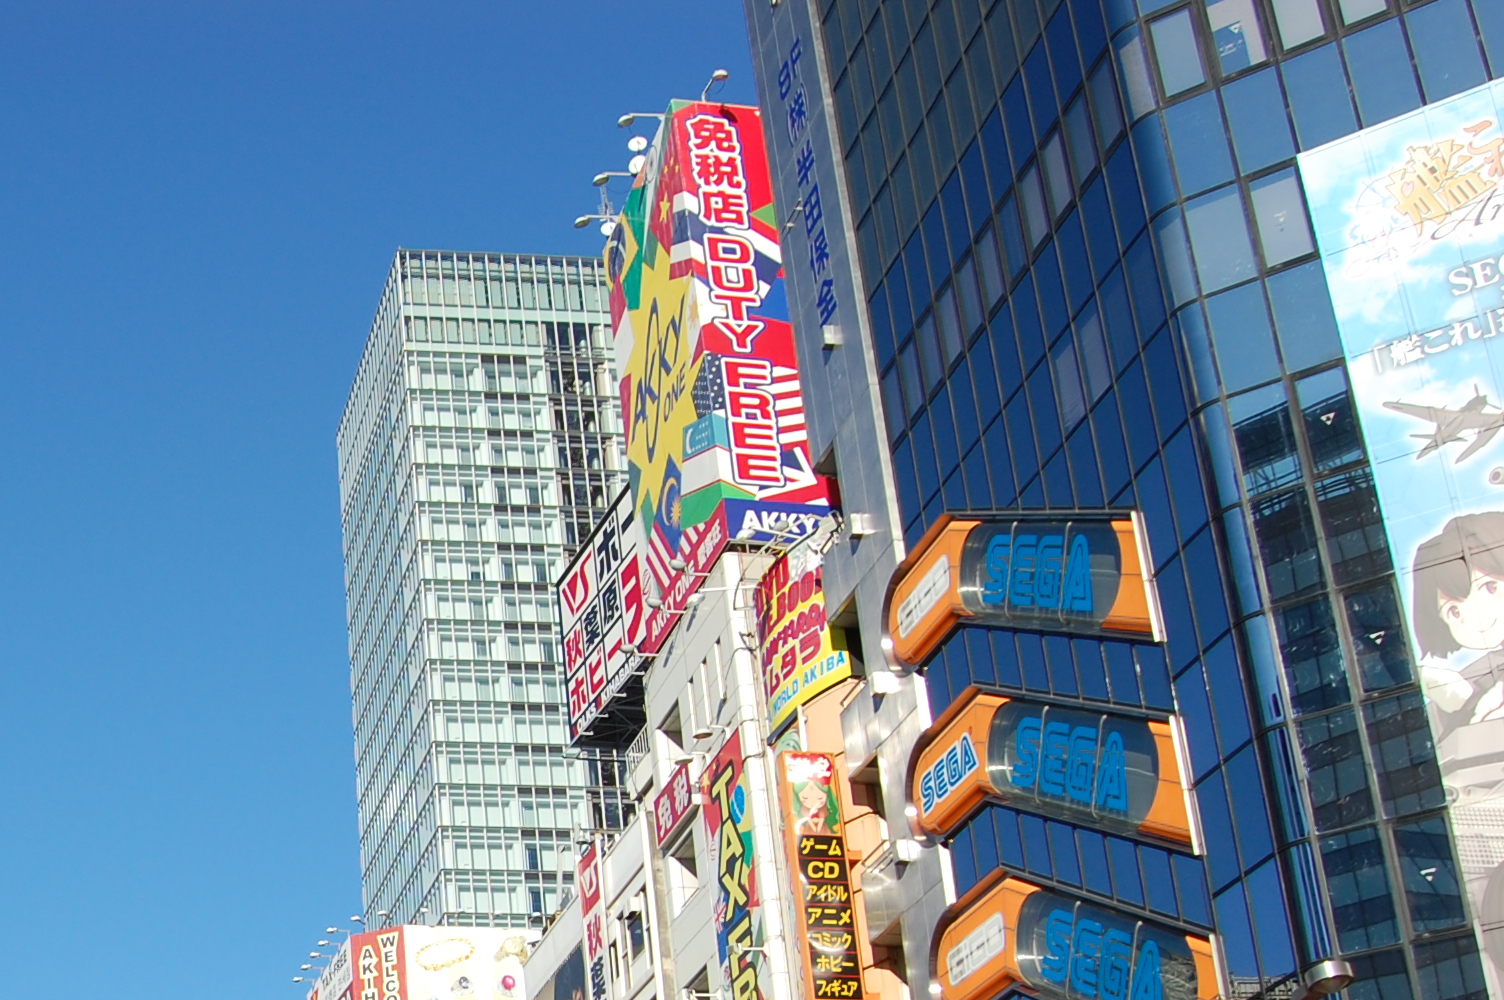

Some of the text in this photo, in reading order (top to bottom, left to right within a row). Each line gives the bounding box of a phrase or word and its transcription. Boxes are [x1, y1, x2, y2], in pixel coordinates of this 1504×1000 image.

[778, 36, 803, 87] 8F
[686, 114, 750, 229] 免税店
[703, 233, 784, 487] DUTY FREE
[983, 534, 1093, 611] SEGA
[566, 577, 620, 672] 秋葉原
[802, 651, 845, 688] AKIBA
[921, 735, 977, 814] SEGA
[1012, 716, 1127, 811] SEGA
[658, 772, 690, 836] 免税
[712, 767, 749, 920] TAX
[801, 838, 842, 857] ゲーム
[806, 884, 848, 902] アイドル
[807, 860, 840, 879] CD
[808, 908, 851, 926] アニメ
[811, 932, 852, 949] コミック
[816, 955, 854, 973] ホビー
[816, 979, 858, 998] フィギュア
